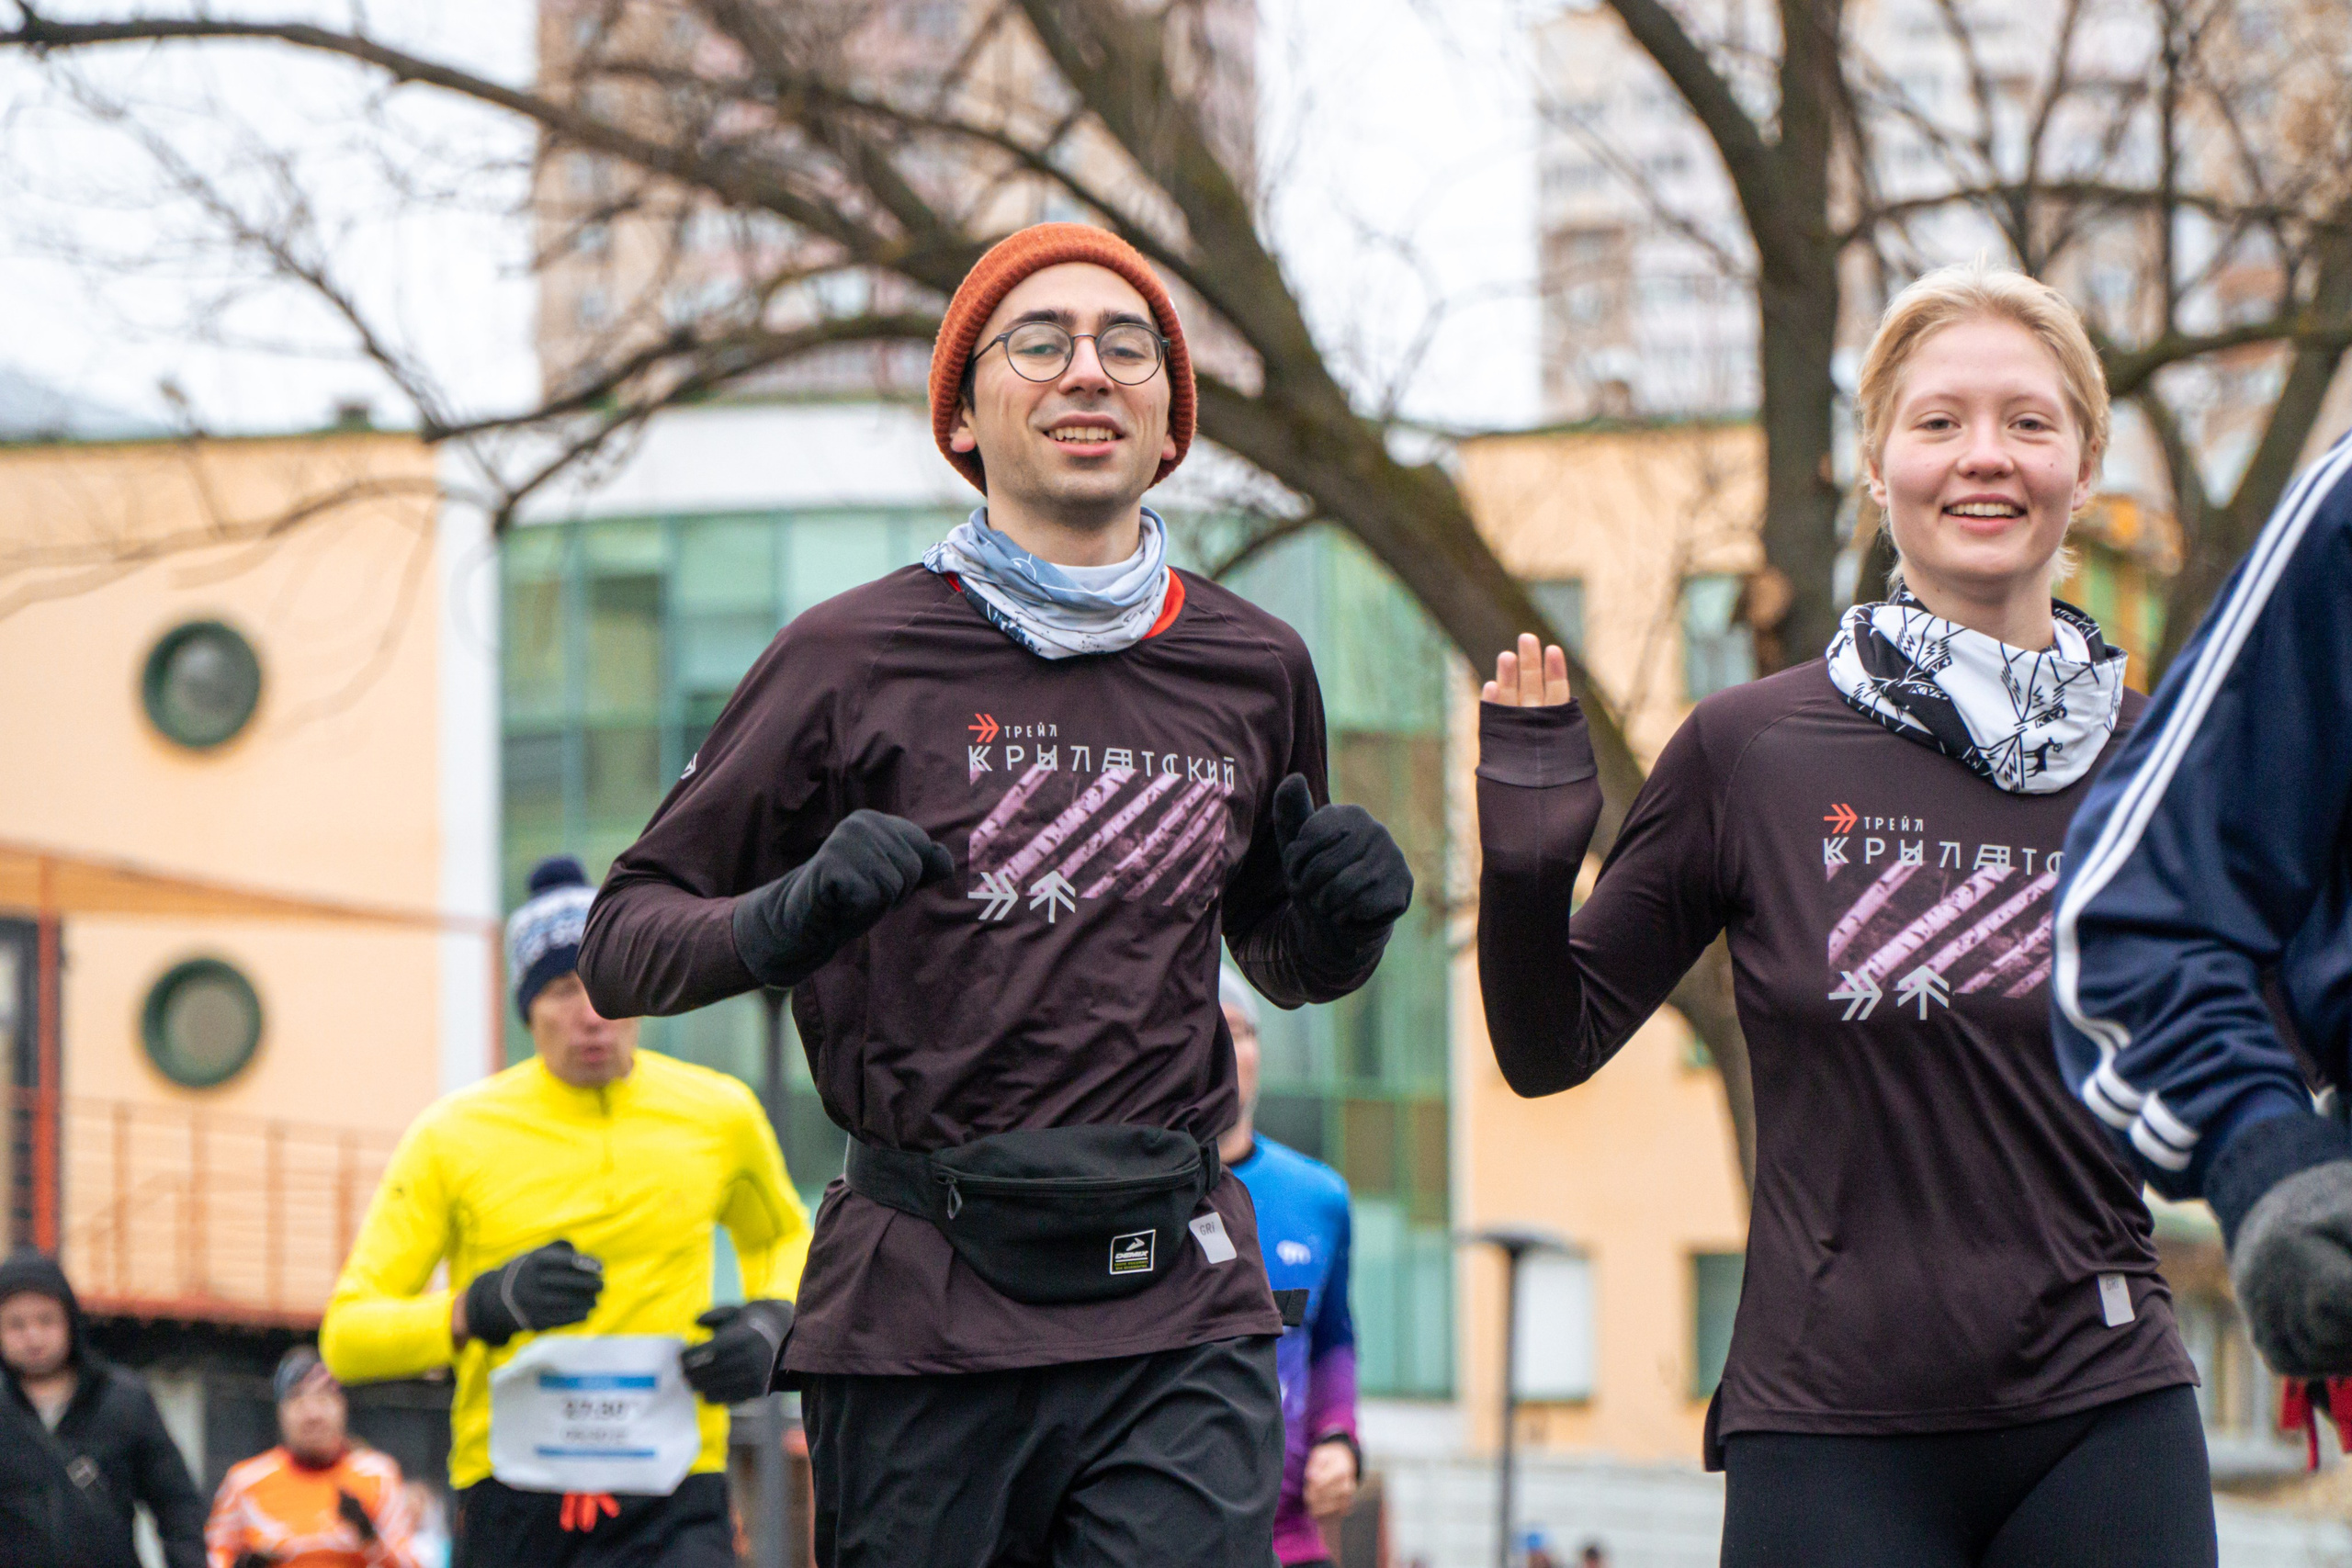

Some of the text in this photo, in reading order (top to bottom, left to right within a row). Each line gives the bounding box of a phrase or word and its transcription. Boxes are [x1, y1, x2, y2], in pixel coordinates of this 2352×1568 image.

[1004, 722, 1057, 738] ТРЕЙЛ
[967, 744, 1235, 790] КРЫЛАТСКИЙ
[1864, 815, 1924, 832] ТРЕЙЛ
